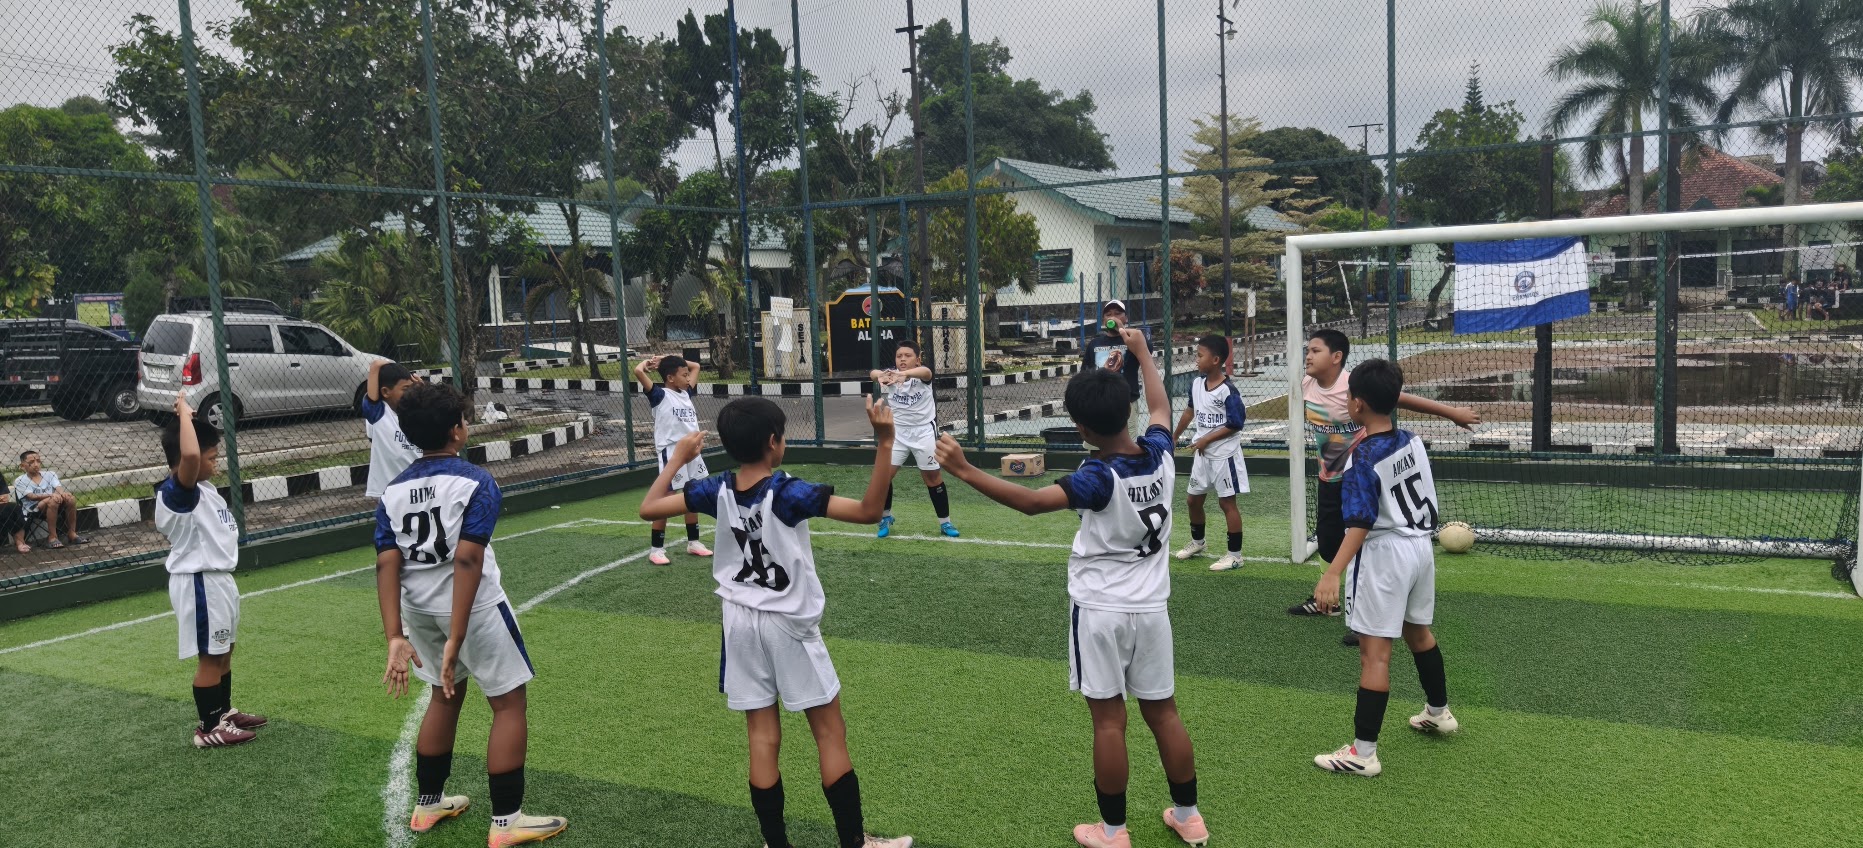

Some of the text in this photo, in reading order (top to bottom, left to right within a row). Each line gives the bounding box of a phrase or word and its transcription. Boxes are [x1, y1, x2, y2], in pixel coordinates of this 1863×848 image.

[797, 323, 806, 364] SETIA
[857, 329, 894, 341] ALHA
[1390, 471, 1438, 531] 15
[400, 505, 451, 564] 21
